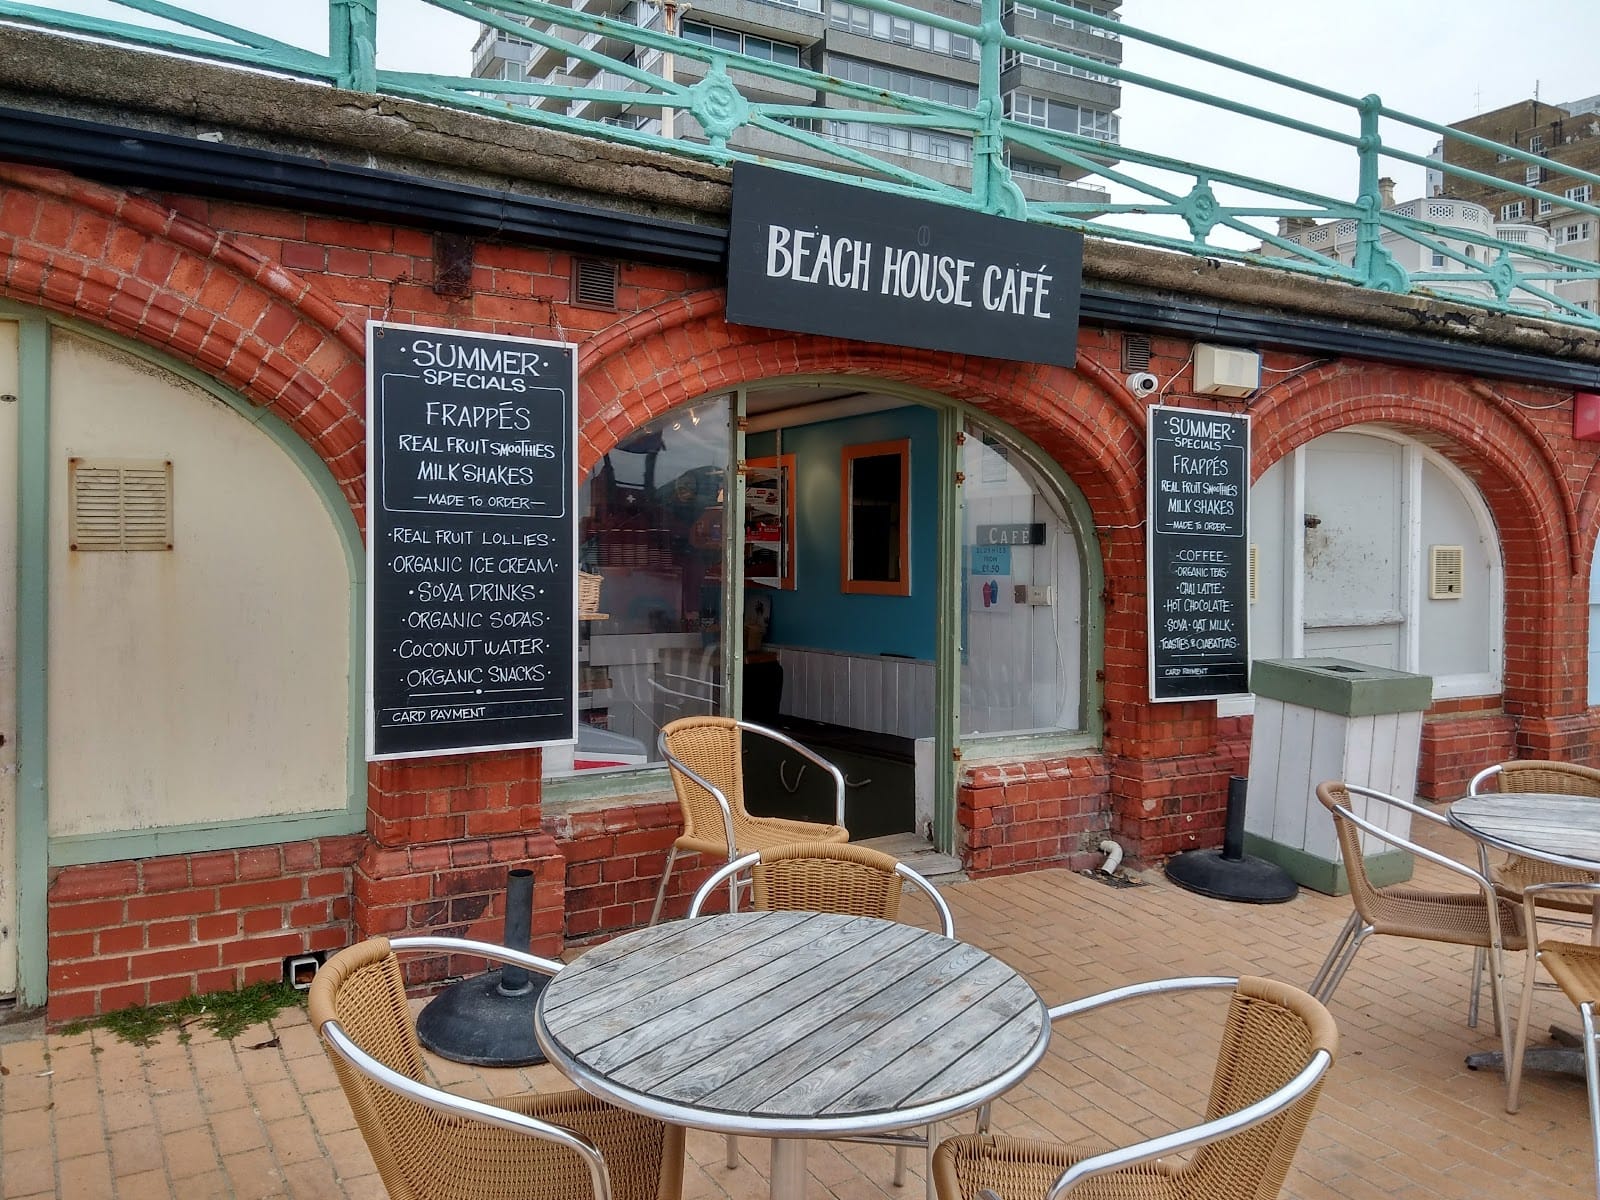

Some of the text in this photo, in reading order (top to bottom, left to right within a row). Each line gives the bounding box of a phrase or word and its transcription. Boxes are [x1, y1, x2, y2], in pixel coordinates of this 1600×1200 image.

[766, 224, 1052, 319] BEACH HOUSE CAFÉ
[412, 340, 540, 376] SUMMER
[423, 369, 526, 392] SPECIALS
[426, 401, 530, 430] FRAPPÉS
[1169, 417, 1231, 440] SUMMER
[400, 435, 555, 458] REAL FRUIT SMOOTHIES
[1175, 437, 1221, 450] SPECIALS
[417, 461, 533, 485] MILK SHAKES
[1173, 455, 1228, 476] FRAPPÉS
[1161, 480, 1179, 492] REAL
[1182, 481, 1202, 493] FRUIT
[429, 494, 530, 509] MADE TO ORDER
[1168, 498, 1234, 515] MILK SHAKES
[1173, 521, 1226, 531] MADE TO ORDER
[393, 528, 548, 546] REAL FRUIT LOLLIES
[988, 527, 1030, 544] CAFÉ
[393, 556, 554, 573] ORGANIC ICE CREAM
[1180, 550, 1224, 562] COFFEE
[1177, 567, 1227, 578] ORGANIC TEAS
[418, 582, 536, 602] SOYA DRINKS
[1198, 583, 1222, 594] LATTE
[1167, 599, 1230, 612] HOT CHOCOLATE
[407, 611, 544, 629] ORGANIC SODAS
[1167, 619, 1188, 632] SOYA
[1210, 619, 1231, 632] MILK
[400, 638, 544, 658] COCONUT WATER
[407, 665, 545, 687] ORGANIC SNACKS
[392, 707, 486, 722] CARD PAYMENT
